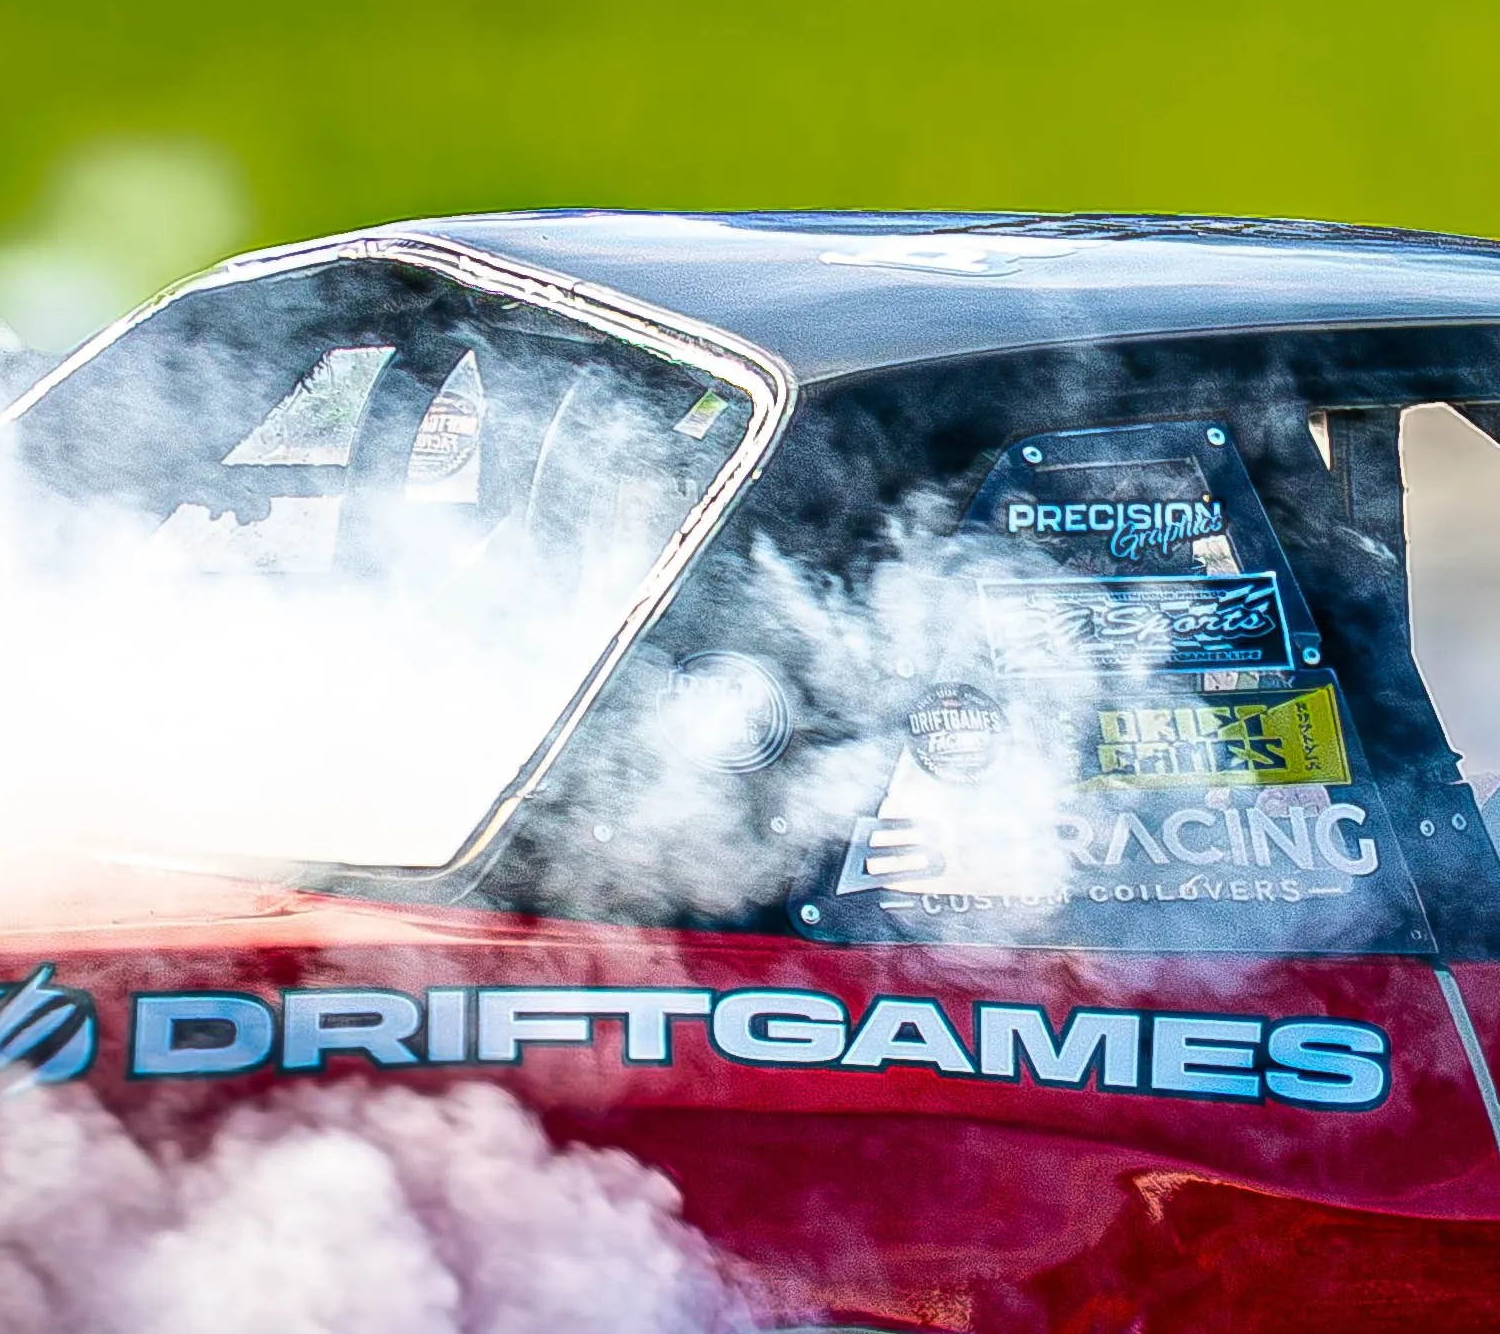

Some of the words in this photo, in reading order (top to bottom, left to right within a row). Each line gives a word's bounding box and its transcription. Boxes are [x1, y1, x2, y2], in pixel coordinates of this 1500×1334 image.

[1008, 503, 1221, 533] PRECISION
[1110, 512, 1223, 562] Graphics
[1101, 603, 1268, 643] Sports
[1088, 879, 1302, 905] COILOVERS
[130, 988, 1390, 1108] DRIFTGAMES
